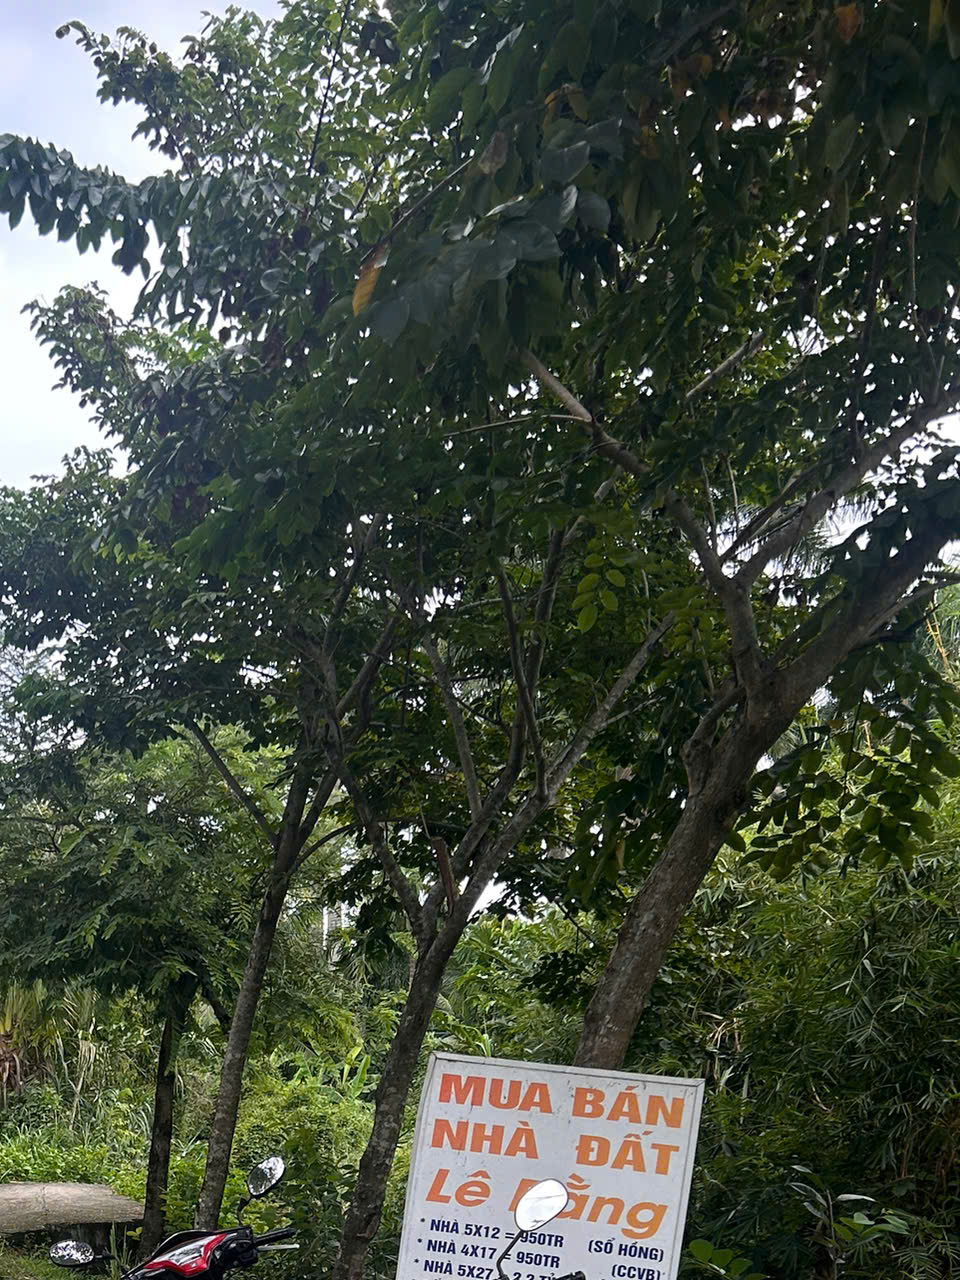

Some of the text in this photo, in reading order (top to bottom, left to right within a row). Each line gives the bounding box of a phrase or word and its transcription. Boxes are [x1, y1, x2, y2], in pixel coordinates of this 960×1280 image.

[438, 1073, 685, 1129] MUA BÁN
[431, 1118, 680, 1176] NHÀ ĐẤT
[425, 1168, 668, 1240] Lê ằng
[426, 1239, 456, 1255] NHÀ
[460, 1244, 497, 1260] 4X17
[516, 1251, 560, 1269] 950TR
[430, 1219, 459, 1234] NHÀ
[464, 1223, 500, 1239] 5X12
[520, 1230, 564, 1248] 950TR
[423, 1260, 453, 1276] NHÀ
[457, 1264, 494, 1280] 5X27
